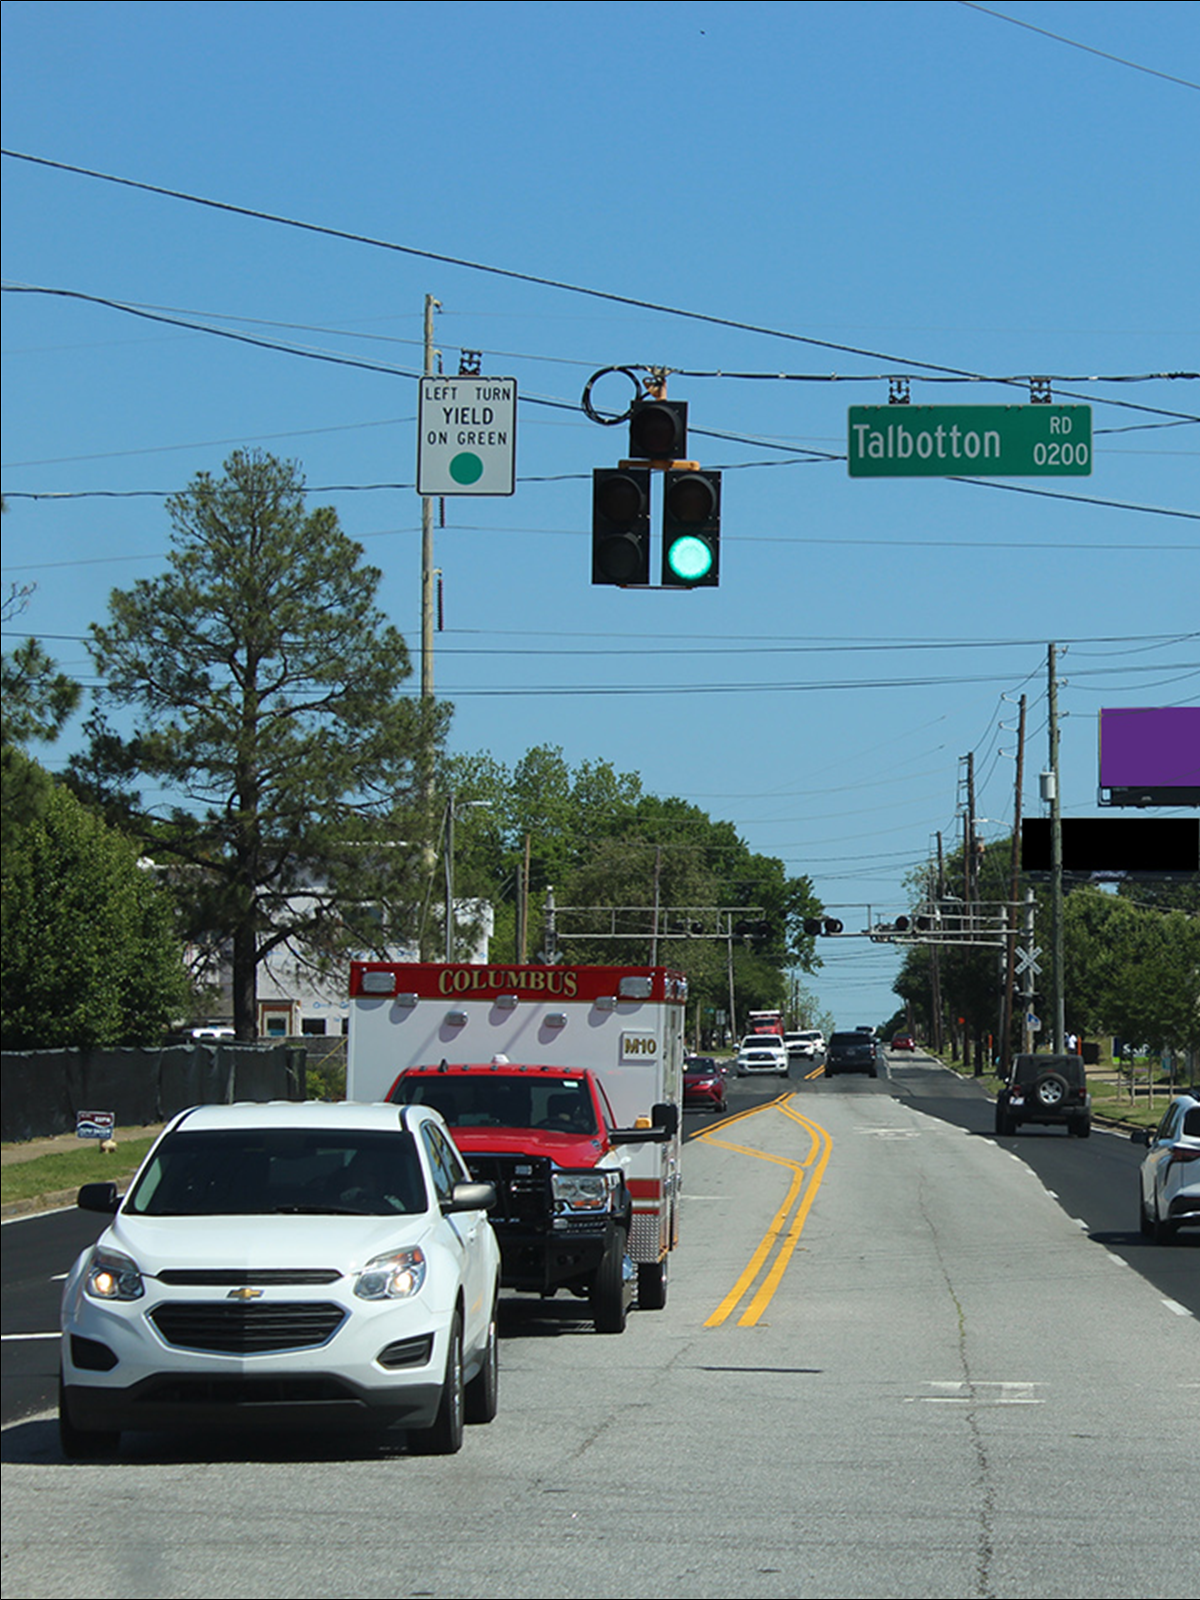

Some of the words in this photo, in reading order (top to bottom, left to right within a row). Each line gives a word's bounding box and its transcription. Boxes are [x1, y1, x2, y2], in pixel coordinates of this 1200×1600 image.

[425, 387, 457, 401] LEFT
[476, 387, 511, 401] TURN
[443, 407, 493, 425] YIELD
[1050, 416, 1072, 434] RD
[427, 431, 447, 445] ON
[457, 431, 507, 446] GREEN
[852, 424, 1001, 458] Talbotton
[1033, 442, 1089, 465] 0200
[438, 969, 578, 998] COLUMBUS
[624, 1037, 657, 1055] M10
